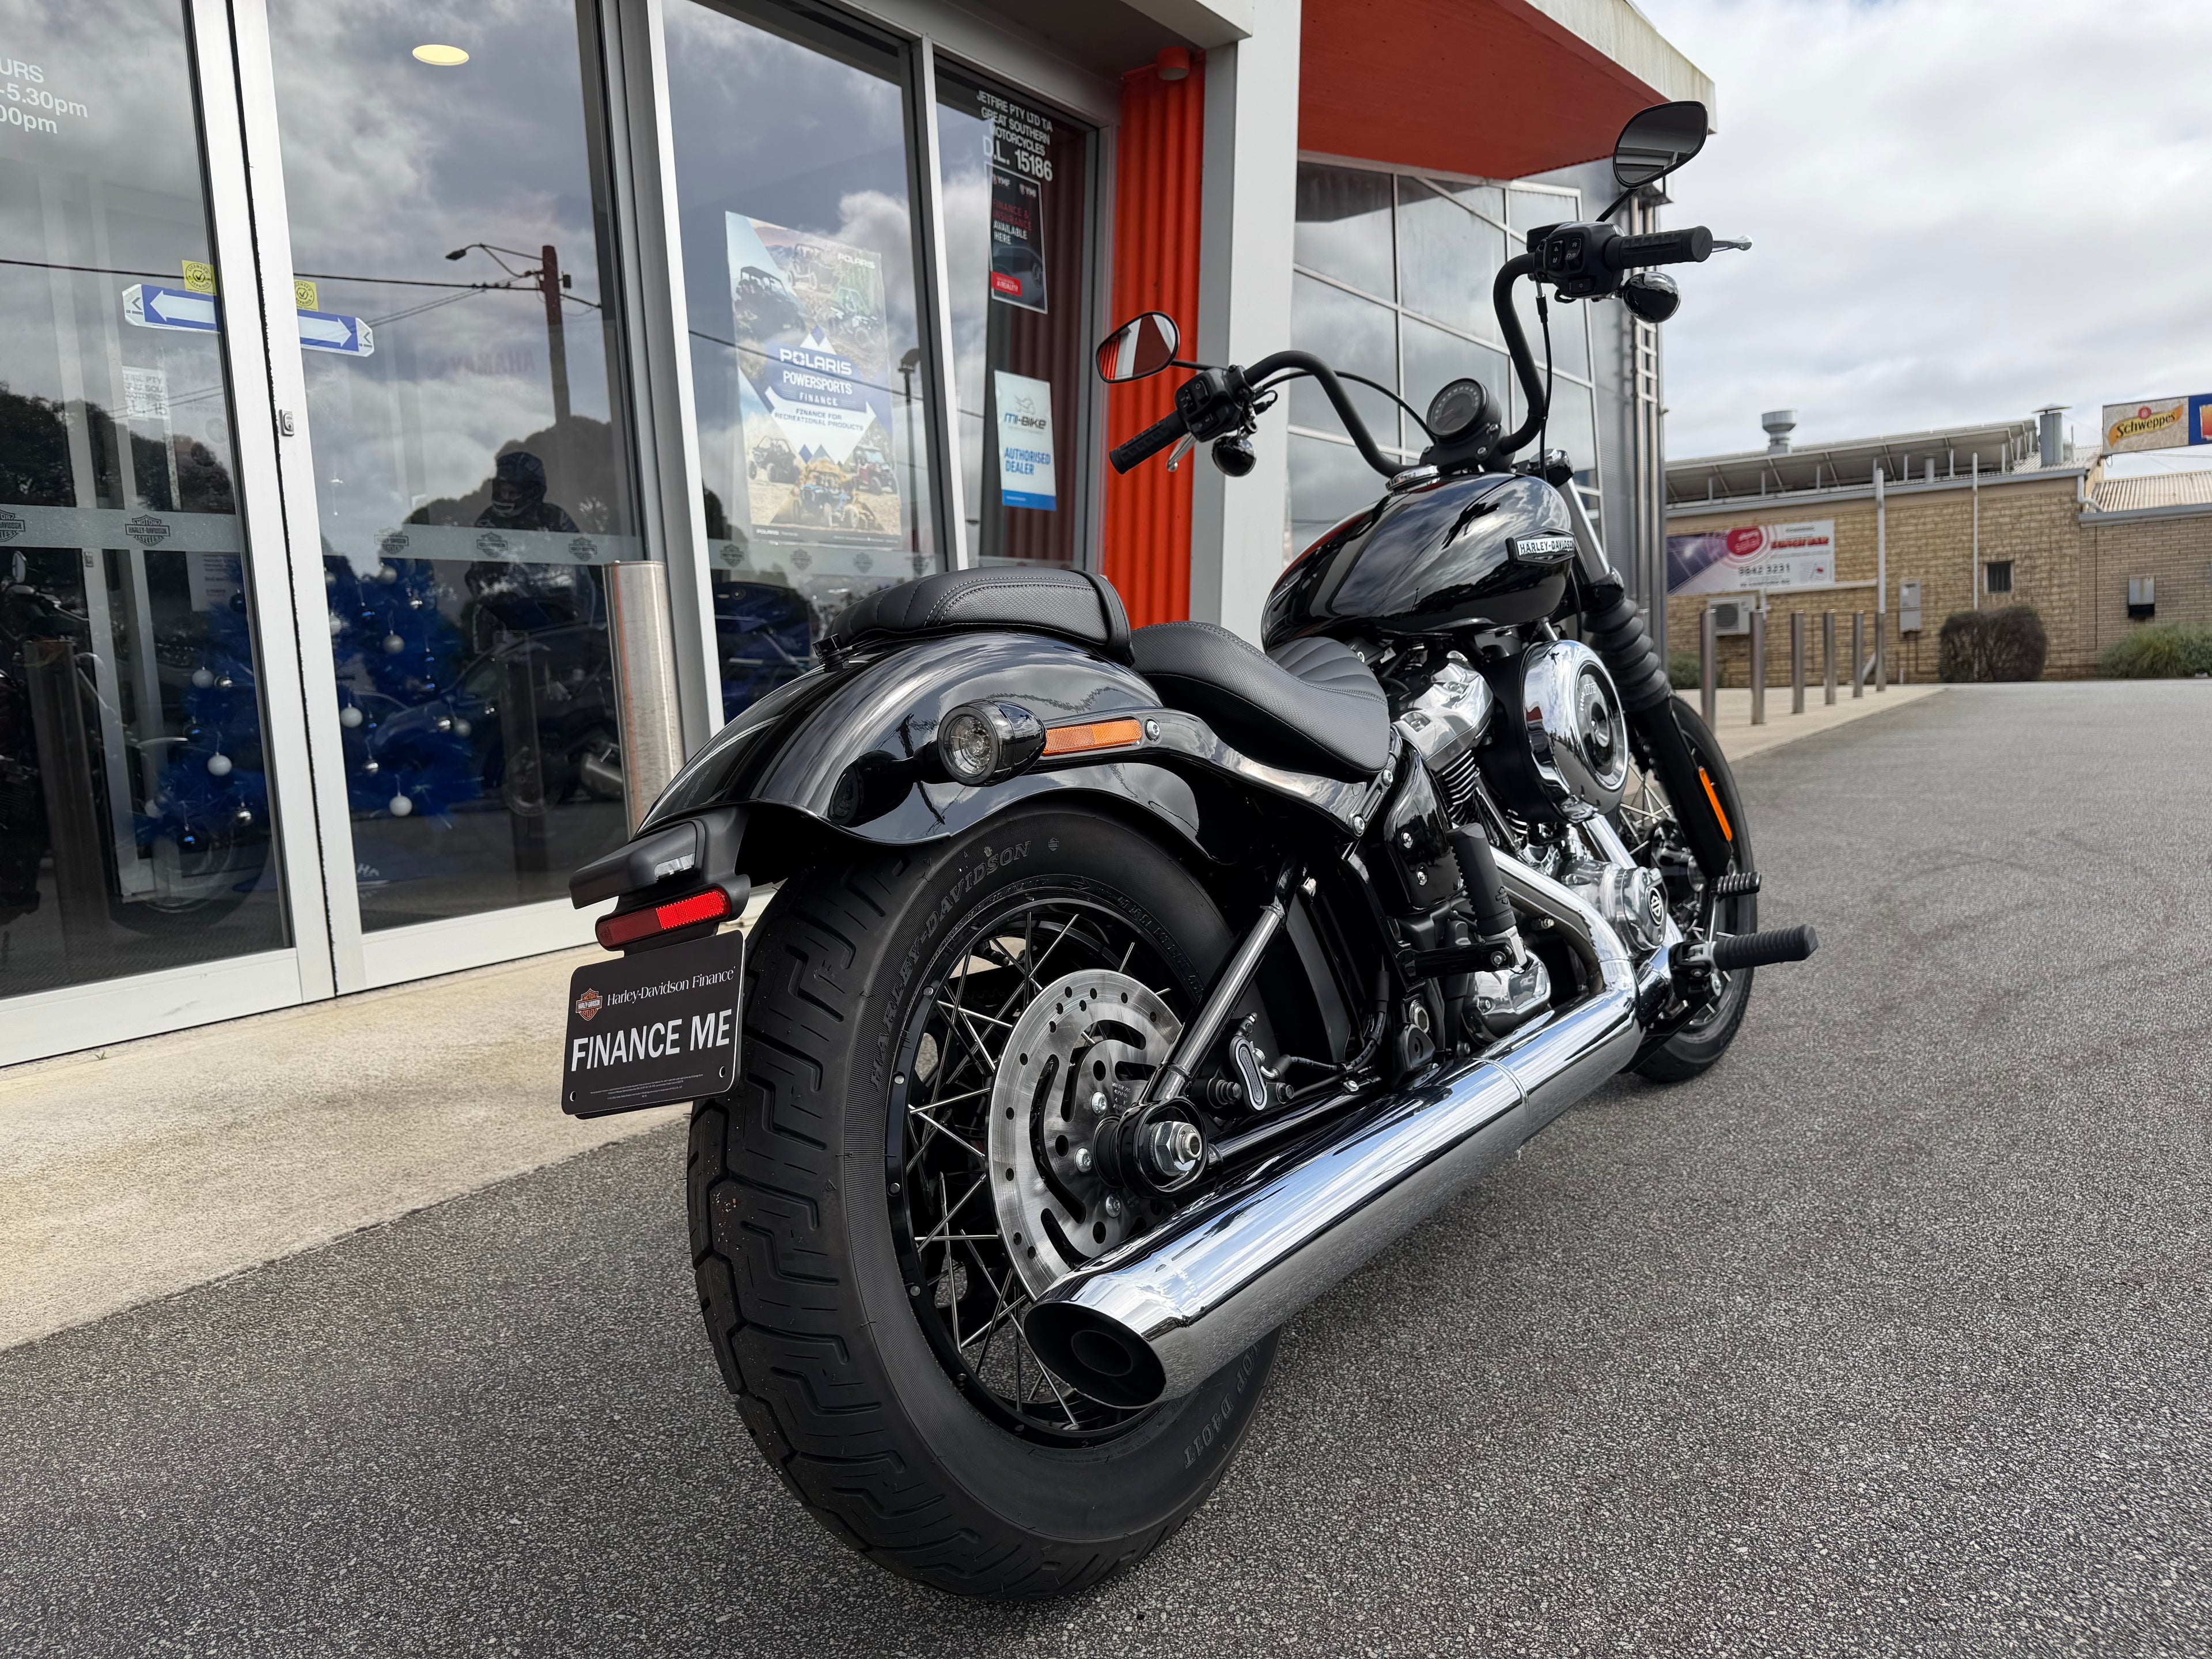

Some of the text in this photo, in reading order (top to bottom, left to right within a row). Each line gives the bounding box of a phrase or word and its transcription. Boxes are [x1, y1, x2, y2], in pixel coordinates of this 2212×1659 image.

[976, 90, 1009, 113] JETFIRE
[1009, 103, 1025, 120] PTY
[1027, 111, 1041, 127] LTD
[981, 106, 1051, 146] GREAT SOUTHERN
[989, 123, 1046, 157] MOTORCYCLES
[1014, 149, 1054, 182] 15186
[993, 220, 1028, 240] AVAILABLE
[994, 230, 1012, 245] HERE
[779, 347, 853, 376] POLARIS
[783, 370, 853, 395] POWERSPORTS
[800, 392, 838, 406] FINANCE
[796, 408, 842, 421] FINANCE FOR
[2116, 411, 2175, 438] Schweppes
[1004, 447, 1051, 465] AUTHORISED
[1005, 460, 1035, 476] DEALER
[1519, 539, 1575, 554] HARLEY-DAVIDSON
[870, 840, 1032, 1088] HARLEY-DAVIDSON
[608, 969, 735, 1006] Harley-Davidson Finance
[571, 1009, 732, 1071] FINANCE ME
